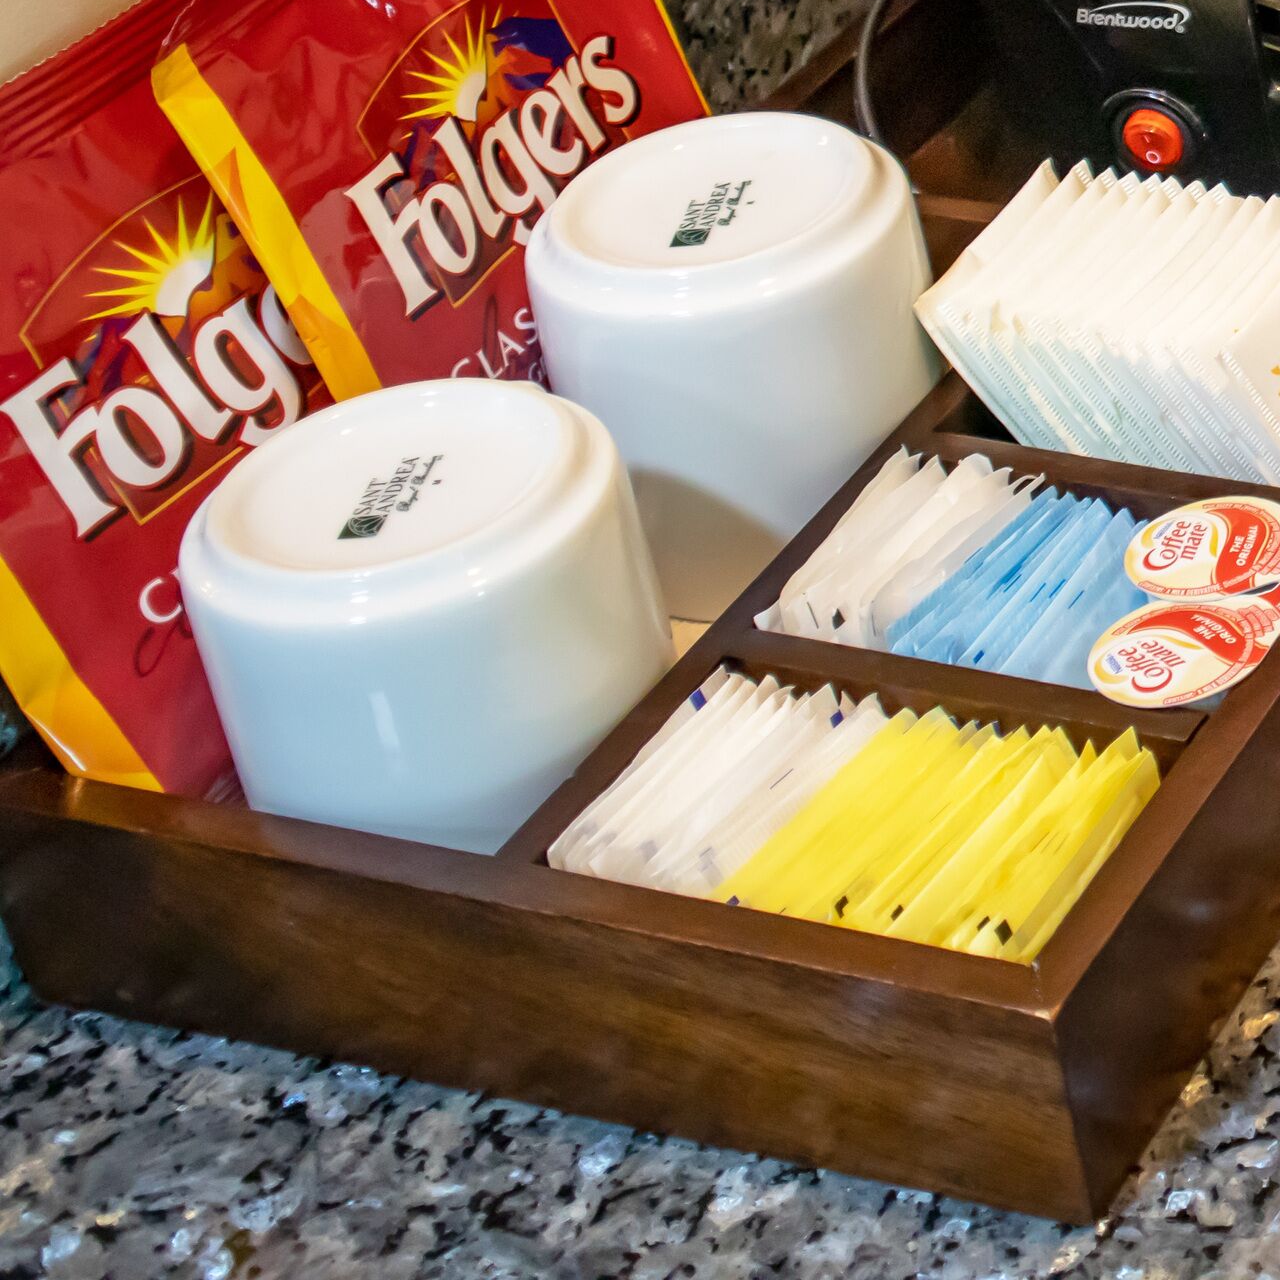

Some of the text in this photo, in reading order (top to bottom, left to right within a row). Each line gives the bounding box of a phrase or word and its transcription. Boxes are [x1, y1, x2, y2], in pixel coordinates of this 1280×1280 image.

[1076, 8, 1179, 30] Brentwood
[345, 34, 641, 320] Folgers
[699, 182, 731, 228] ANDREA
[451, 307, 538, 379] CLAS
[0, 282, 314, 542] Folg
[376, 457, 420, 513] ANDREA
[1142, 520, 1191, 571] Coffee
[1180, 521, 1208, 560] mate
[1230, 535, 1244, 554] THE
[1235, 524, 1259, 566] ORIGINAL
[1190, 613, 1237, 644] ORIGINAL
[1193, 626, 1217, 641] THE
[1116, 647, 1172, 693] Coffee
[1138, 639, 1186, 667] mate
